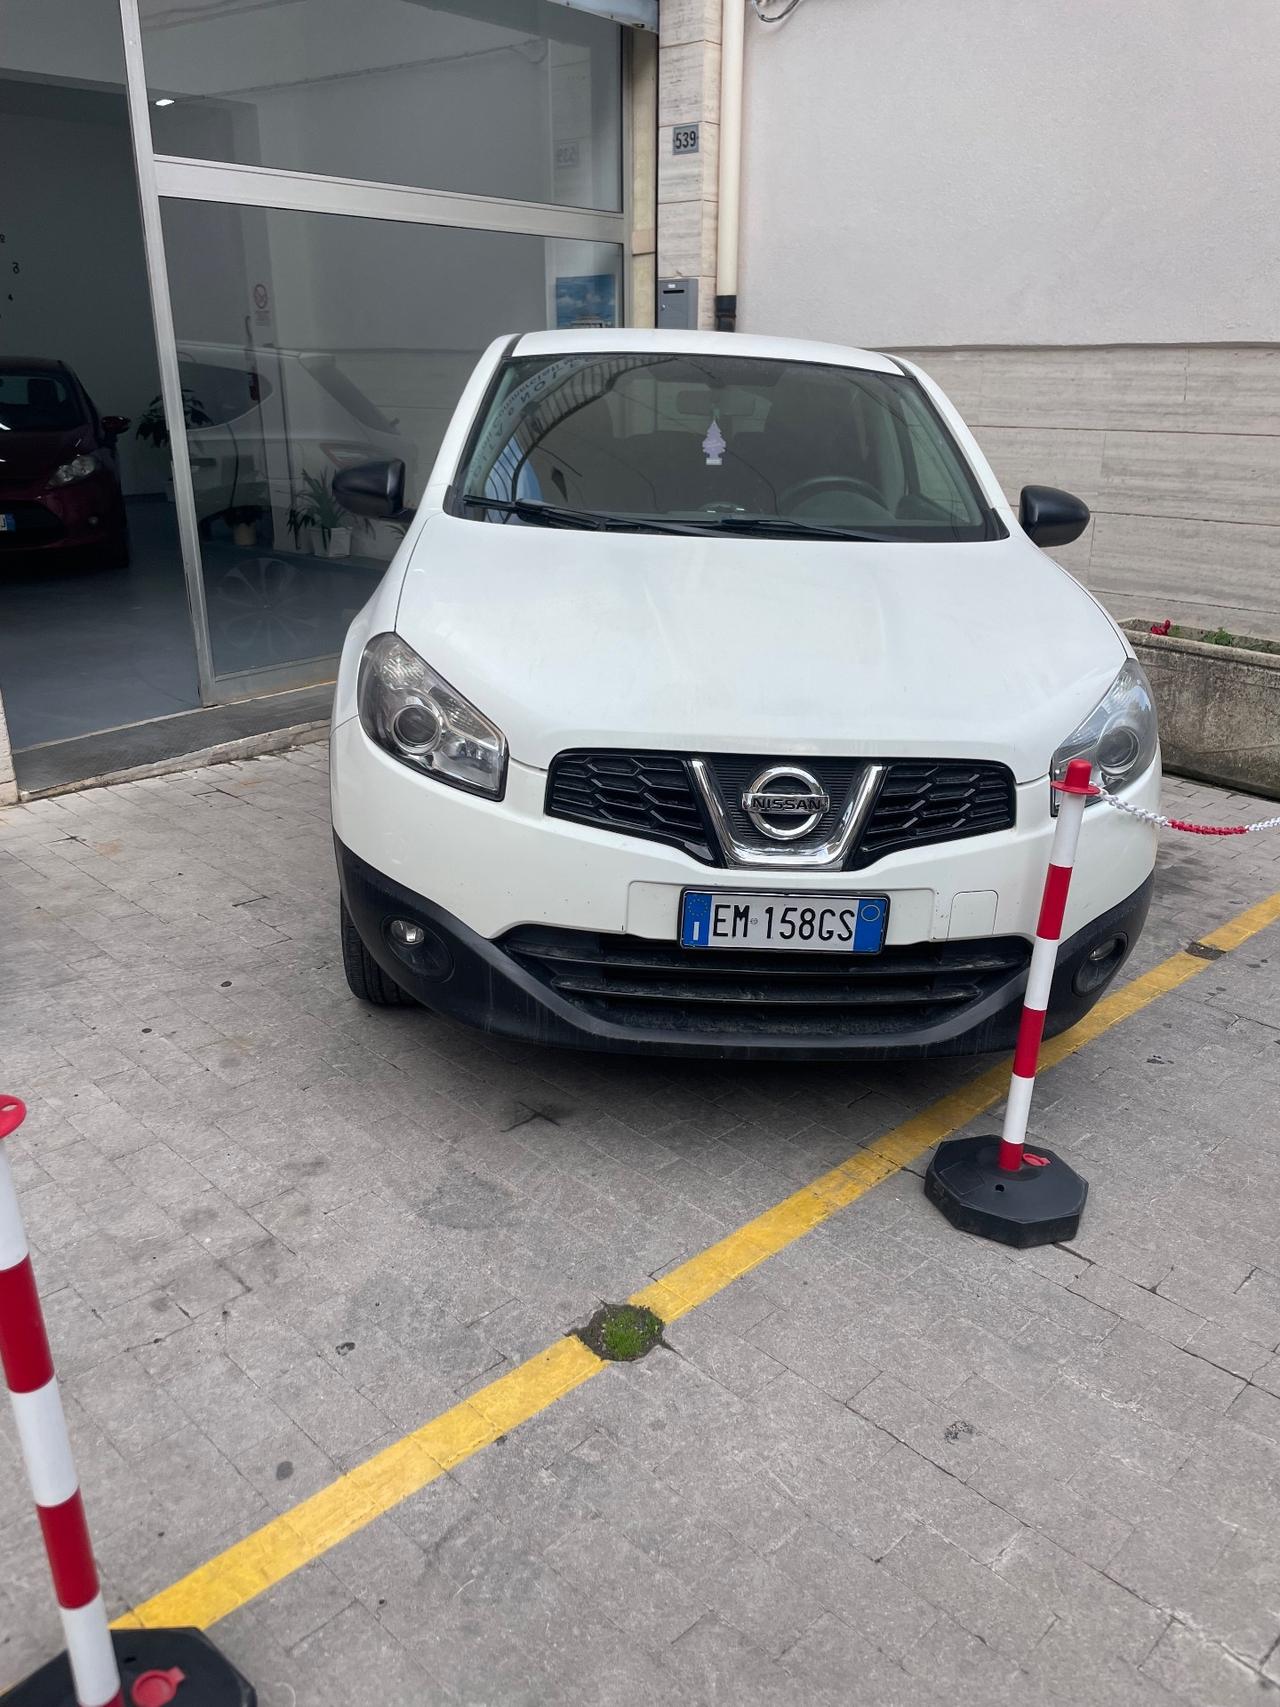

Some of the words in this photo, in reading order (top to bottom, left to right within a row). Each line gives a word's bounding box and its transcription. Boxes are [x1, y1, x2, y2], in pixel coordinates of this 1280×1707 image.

[675, 130, 696, 150] 539
[752, 798, 820, 810] NISSAN
[712, 904, 750, 938] EM
[764, 906, 855, 942] 158GS
